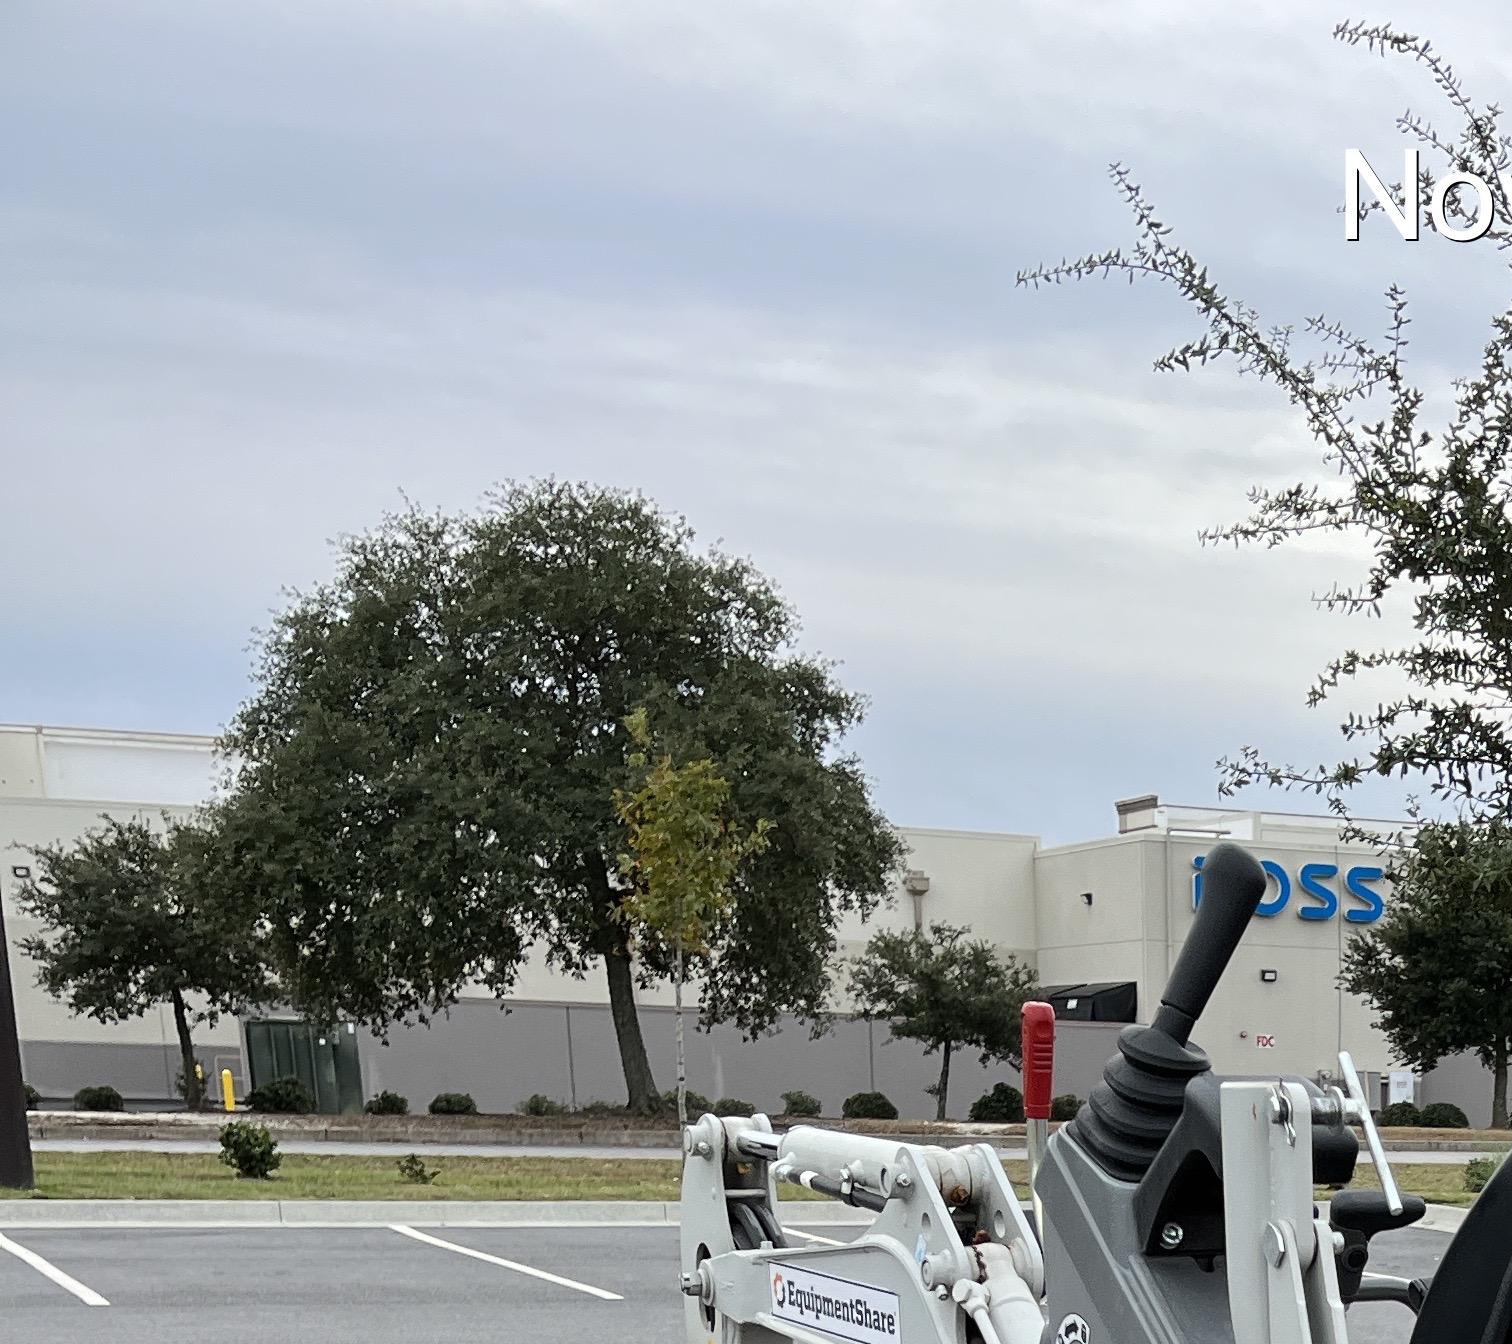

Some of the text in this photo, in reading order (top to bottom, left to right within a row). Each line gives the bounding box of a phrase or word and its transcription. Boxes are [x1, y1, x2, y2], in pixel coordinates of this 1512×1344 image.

[1192, 856, 1385, 922] OSS
[1256, 1035, 1275, 1048] FDC
[786, 1279, 896, 1336] EquipmentShare
